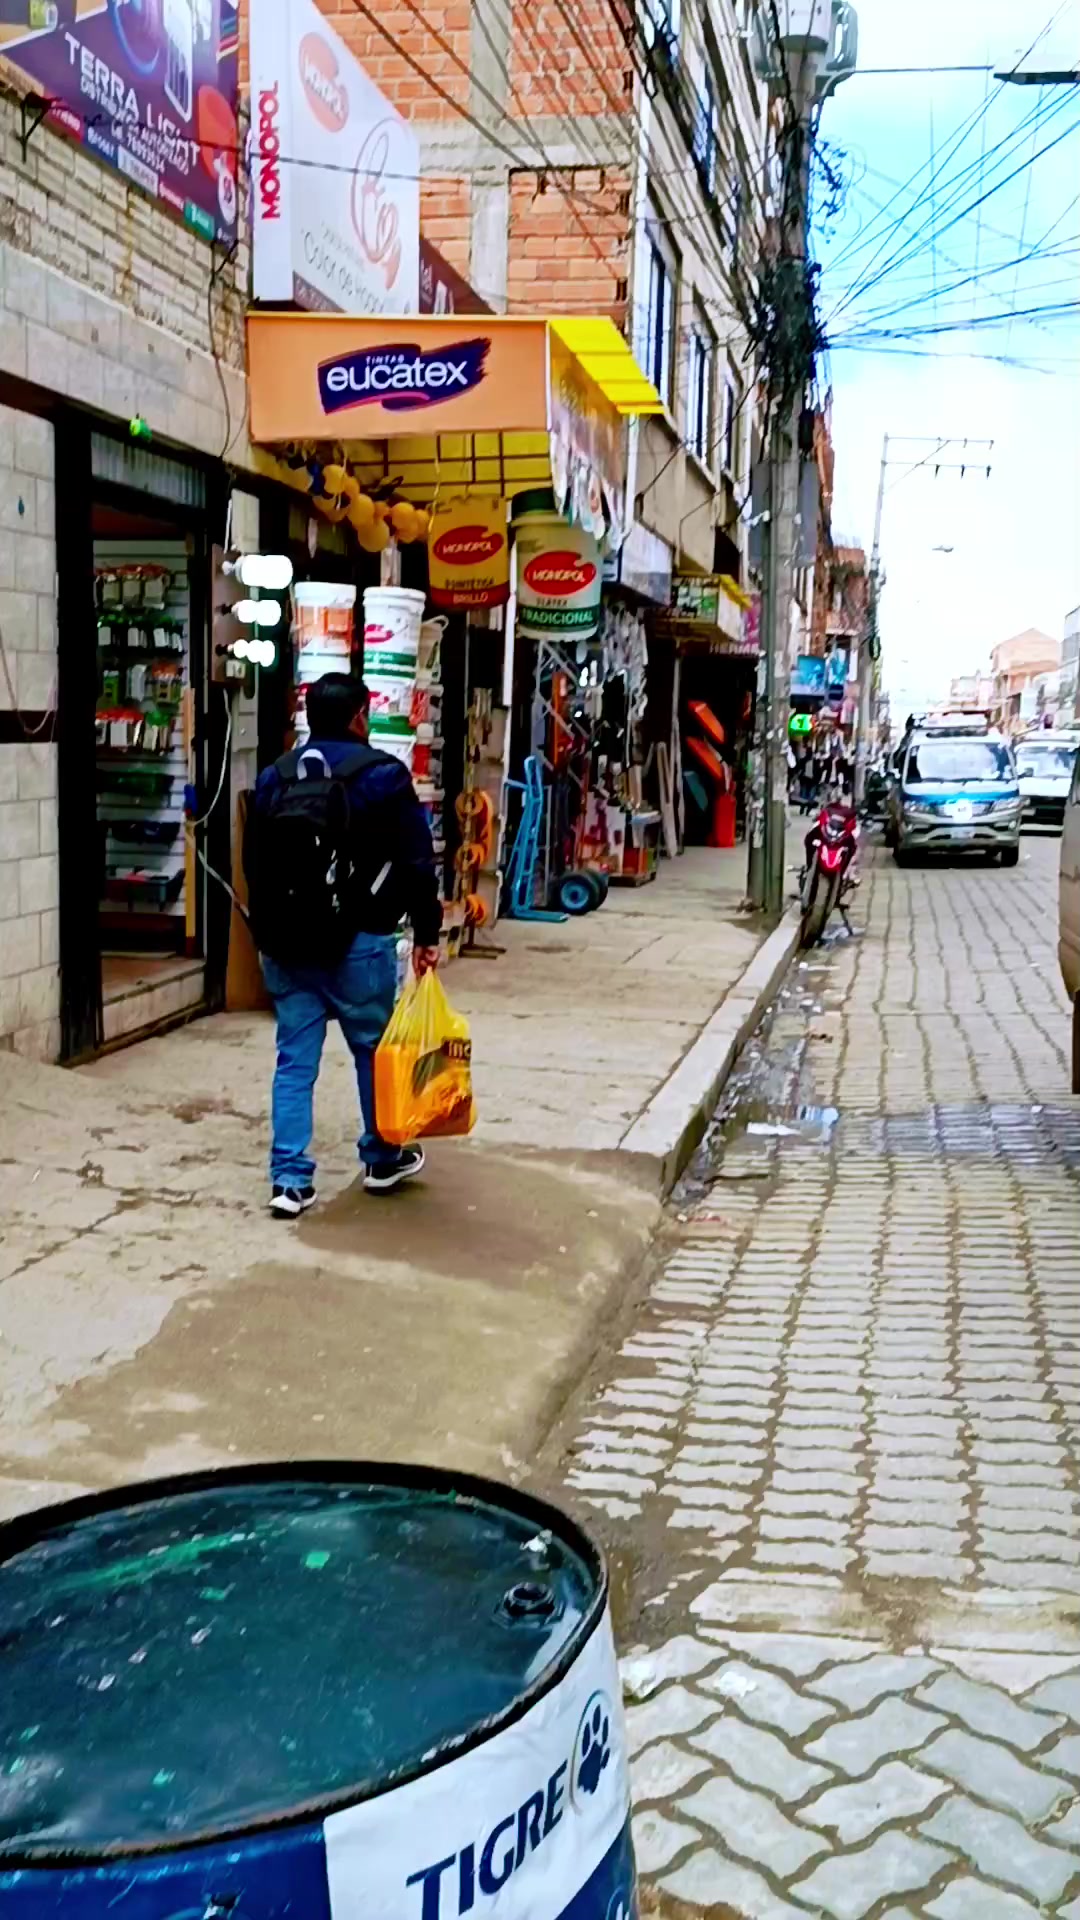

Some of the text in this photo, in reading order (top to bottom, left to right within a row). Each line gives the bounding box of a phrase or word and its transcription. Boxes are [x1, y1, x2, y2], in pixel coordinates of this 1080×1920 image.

[65, 32, 140, 121] TERRA
[147, 103, 200, 166] LIGHT
[259, 80, 281, 219] MONOPOL
[326, 357, 468, 391] eucatex
[523, 608, 594, 625] TRADICIONAL
[406, 1758, 568, 1919] TIGRE
